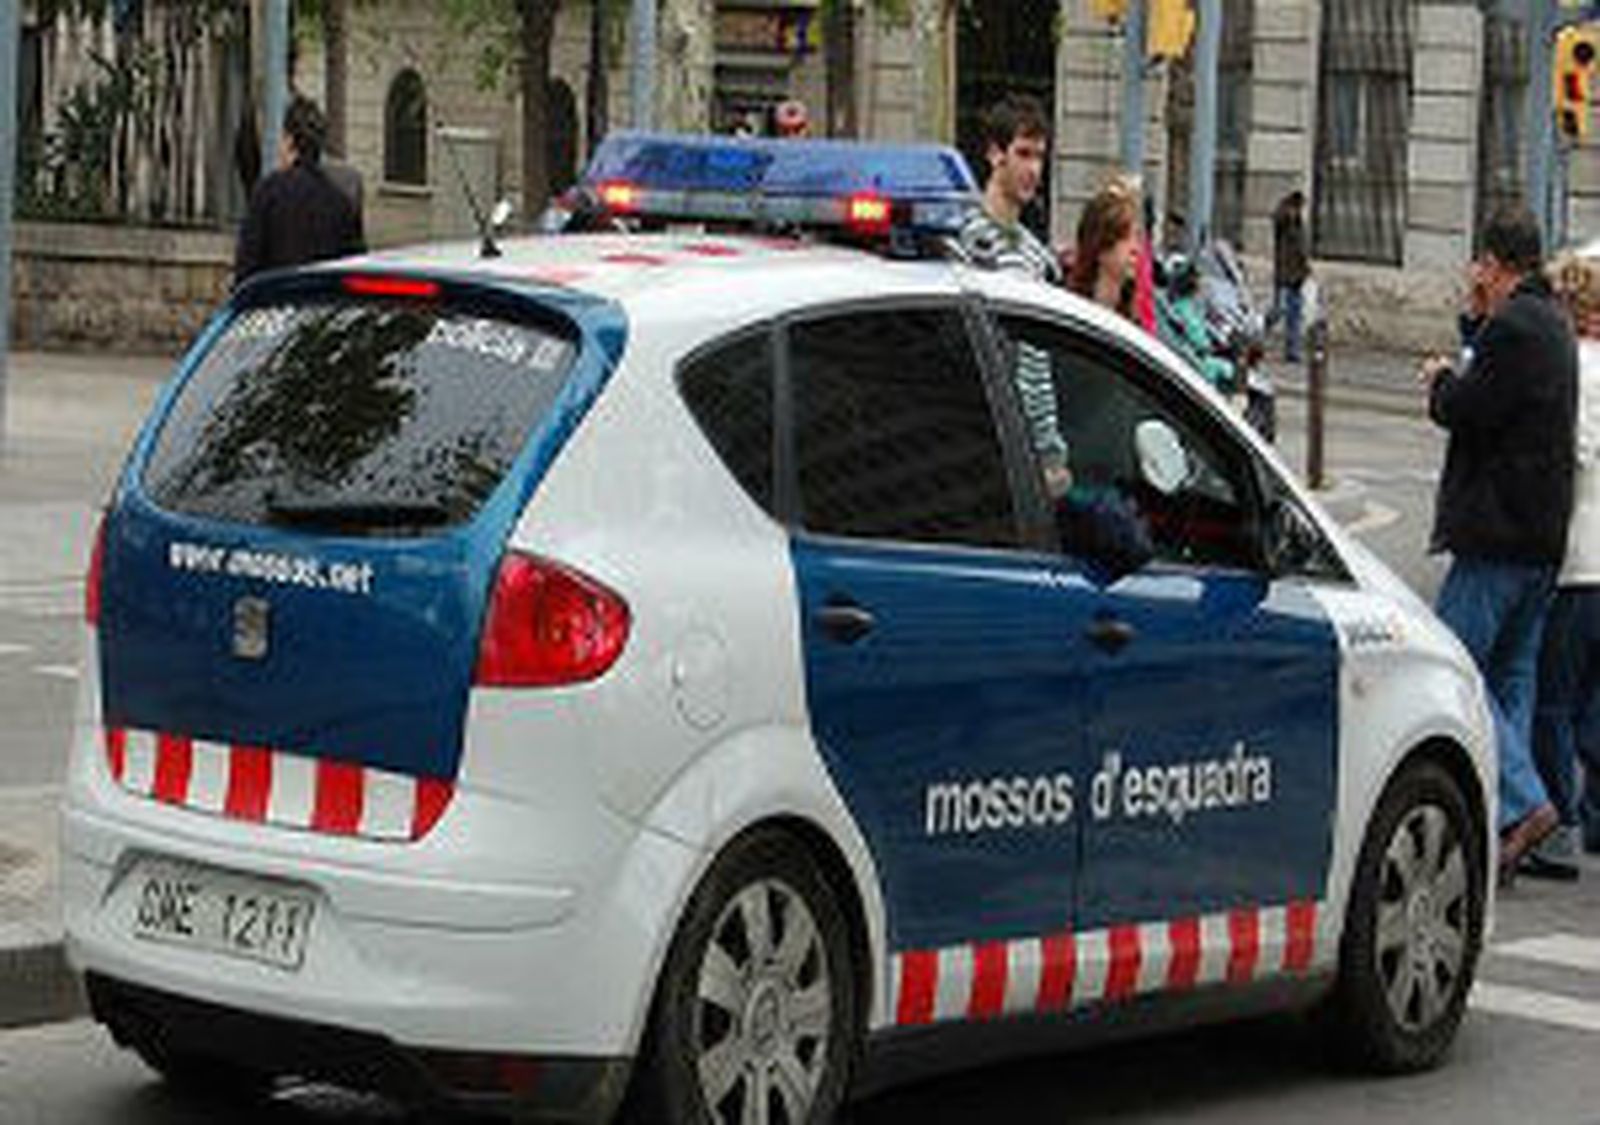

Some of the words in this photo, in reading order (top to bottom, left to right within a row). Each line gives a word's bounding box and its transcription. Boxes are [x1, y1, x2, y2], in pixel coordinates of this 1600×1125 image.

[169, 541, 374, 594] www.mossos.net
[925, 771, 1075, 835] mossos
[1090, 740, 1271, 824] d'esquadra
